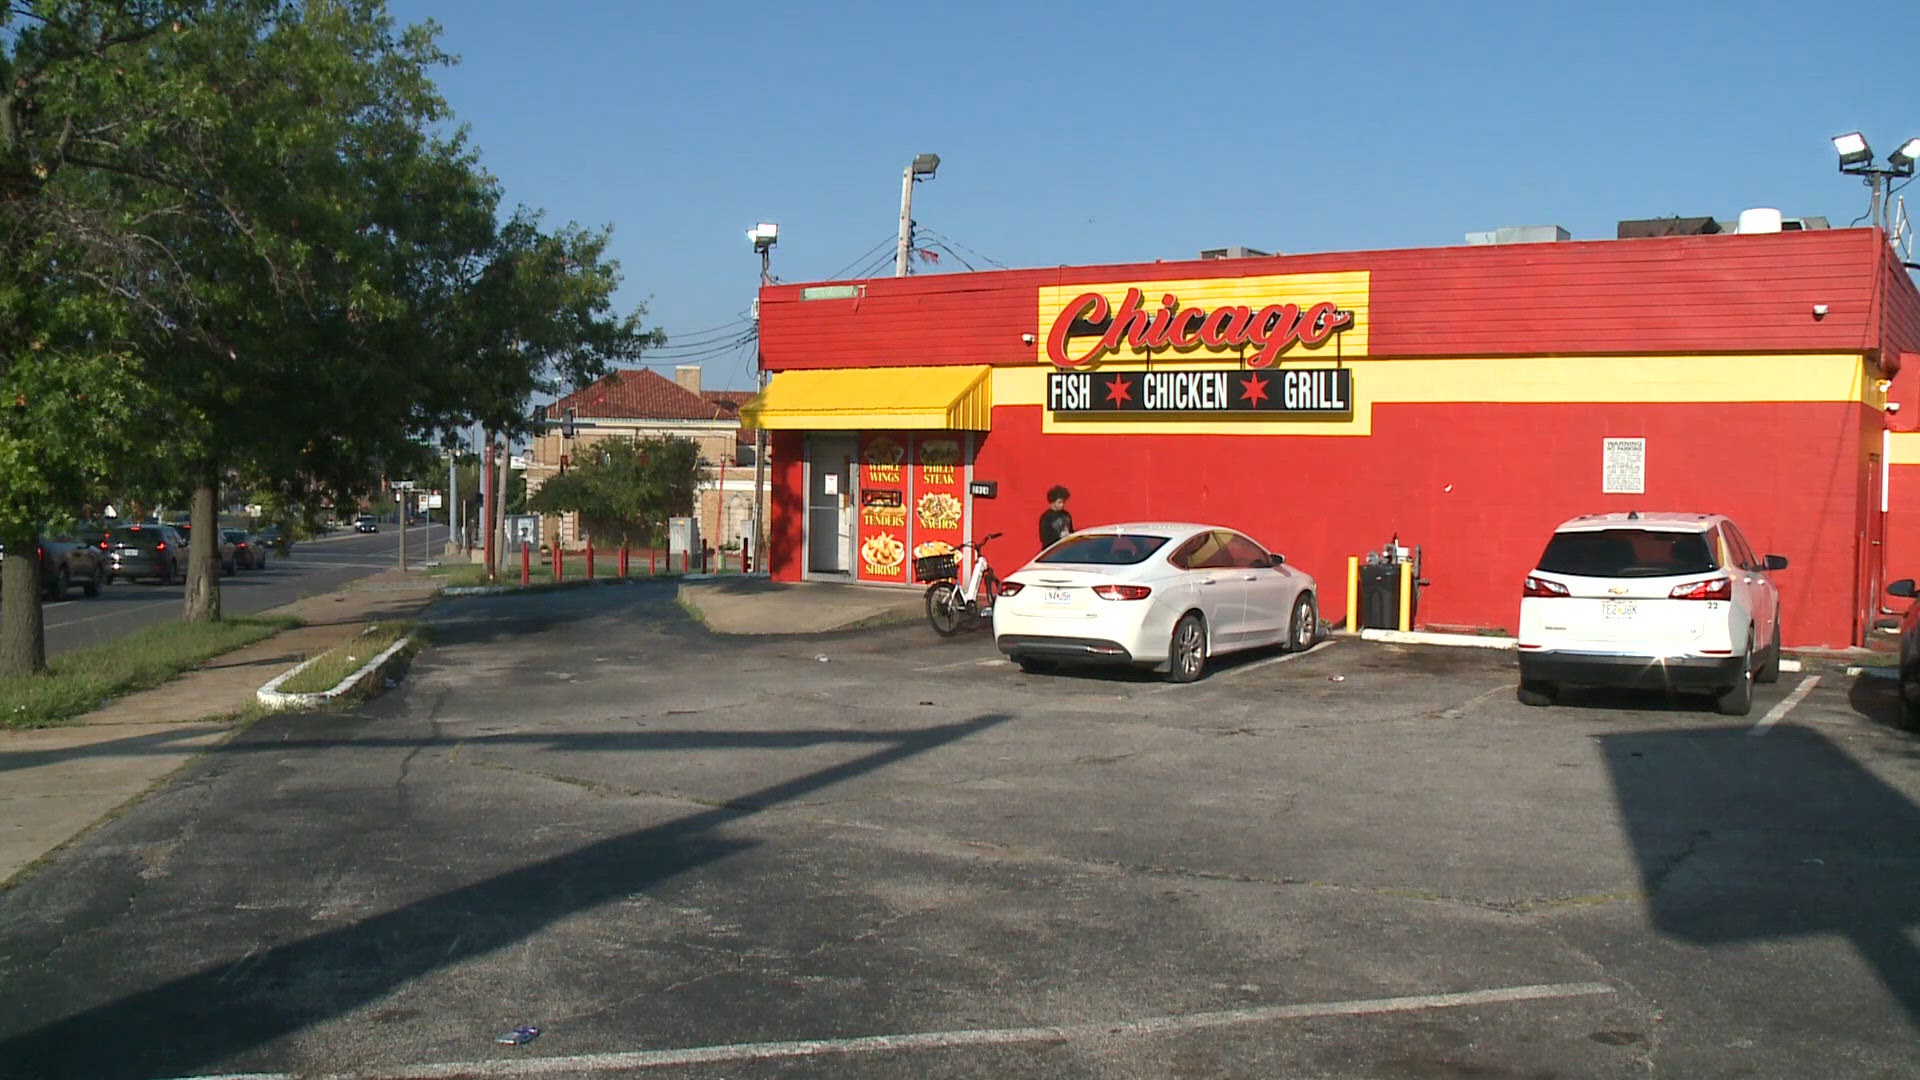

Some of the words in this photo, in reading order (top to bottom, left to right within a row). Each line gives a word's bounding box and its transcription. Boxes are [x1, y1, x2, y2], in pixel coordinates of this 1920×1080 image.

[1046, 287, 1350, 368] Chicago
[1051, 374, 1091, 409] FISH
[1143, 373, 1228, 409] CHICKEN
[1284, 371, 1344, 409] GRILL
[869, 462, 901, 472] WHOLE
[923, 464, 955, 473] PHILLY
[869, 472, 900, 482] WINGS
[923, 474, 955, 485] STEAK
[864, 515, 905, 527] TENDERS
[920, 519, 958, 530] NACHOS
[865, 565, 901, 576] SHRIMP
[1707, 601, 1718, 609] 22
